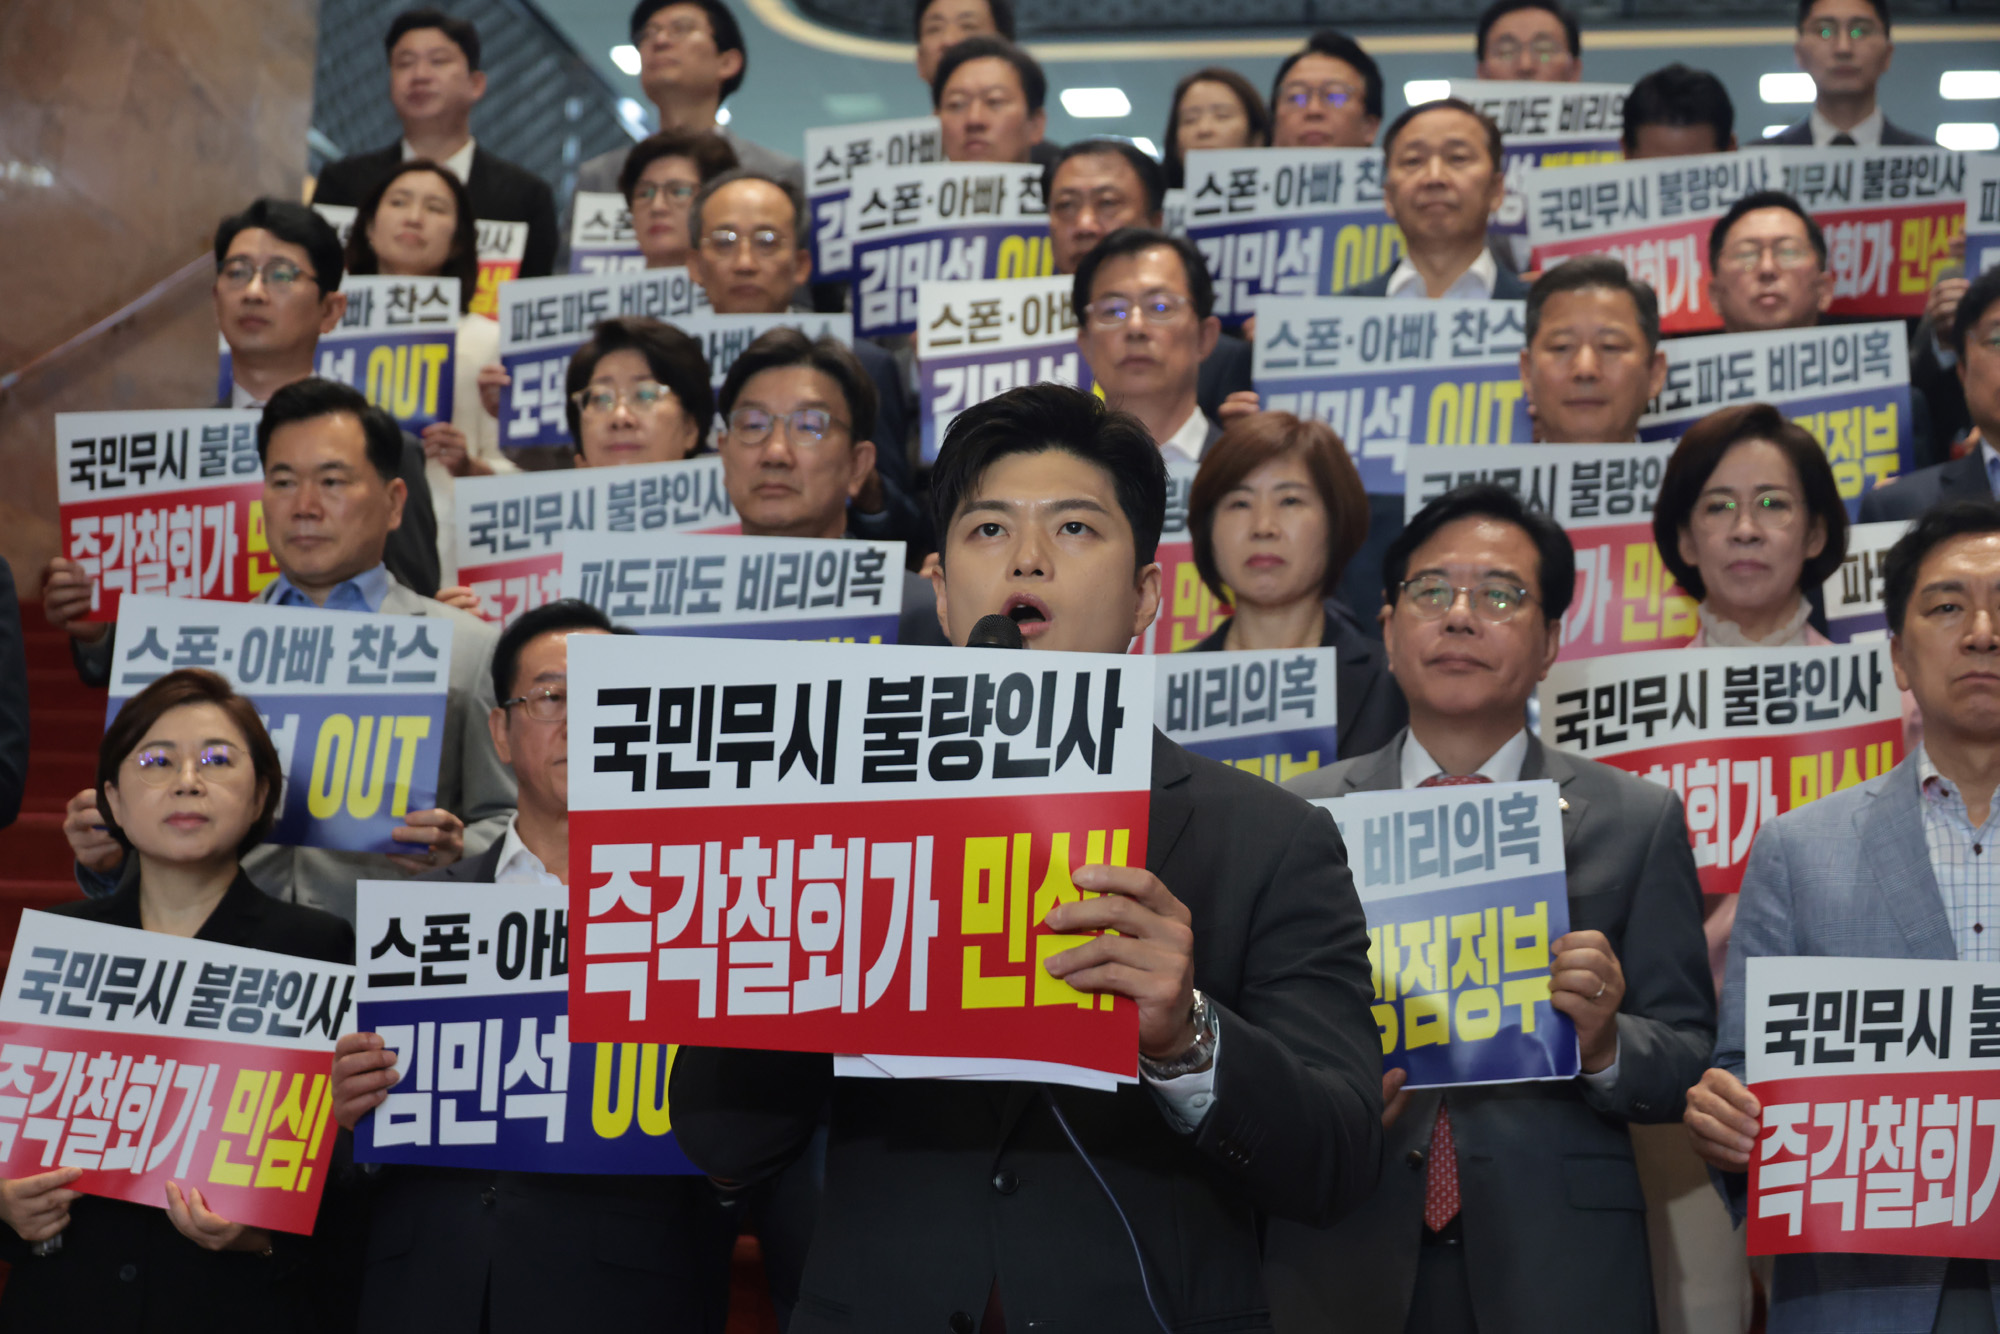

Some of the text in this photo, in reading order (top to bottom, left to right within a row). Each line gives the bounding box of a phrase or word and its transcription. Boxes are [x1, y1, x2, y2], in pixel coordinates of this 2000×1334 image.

[858, 176, 1006, 232] 스폰·아빠
[1193, 160, 1342, 217] 스폰·아빠
[1539, 176, 1648, 234] 국민무시
[1863, 153, 1966, 201] 불량인사
[620, 276, 713, 318] 비리의
[1824, 219, 1895, 298] 회가
[386, 283, 449, 325] 찬스
[1263, 307, 1526, 369] 스폰·아빠 찬스
[366, 343, 449, 419] OUT
[1650, 327, 1891, 418] 도파도 비리의혹
[70, 427, 190, 491] 국민무시
[469, 485, 597, 555] 국민무시
[580, 556, 727, 618] 파도파도
[736, 546, 887, 612] 비리의혹
[346, 624, 440, 685] 찬스
[1165, 654, 1318, 732] 비리의혹
[593, 668, 1126, 792] 국민무시 불량인사
[1555, 650, 1883, 751] 국민무시 불량인사
[306, 713, 431, 819] OUT
[1363, 791, 1540, 888] 비리의혹
[585, 834, 939, 1022] 즉각철회가
[18, 946, 356, 1041] 국민무시 불량인사
[1764, 985, 1954, 1066] 국민무시
[372, 1014, 571, 1149] 김민석
[207, 1068, 333, 1193] 민심!
